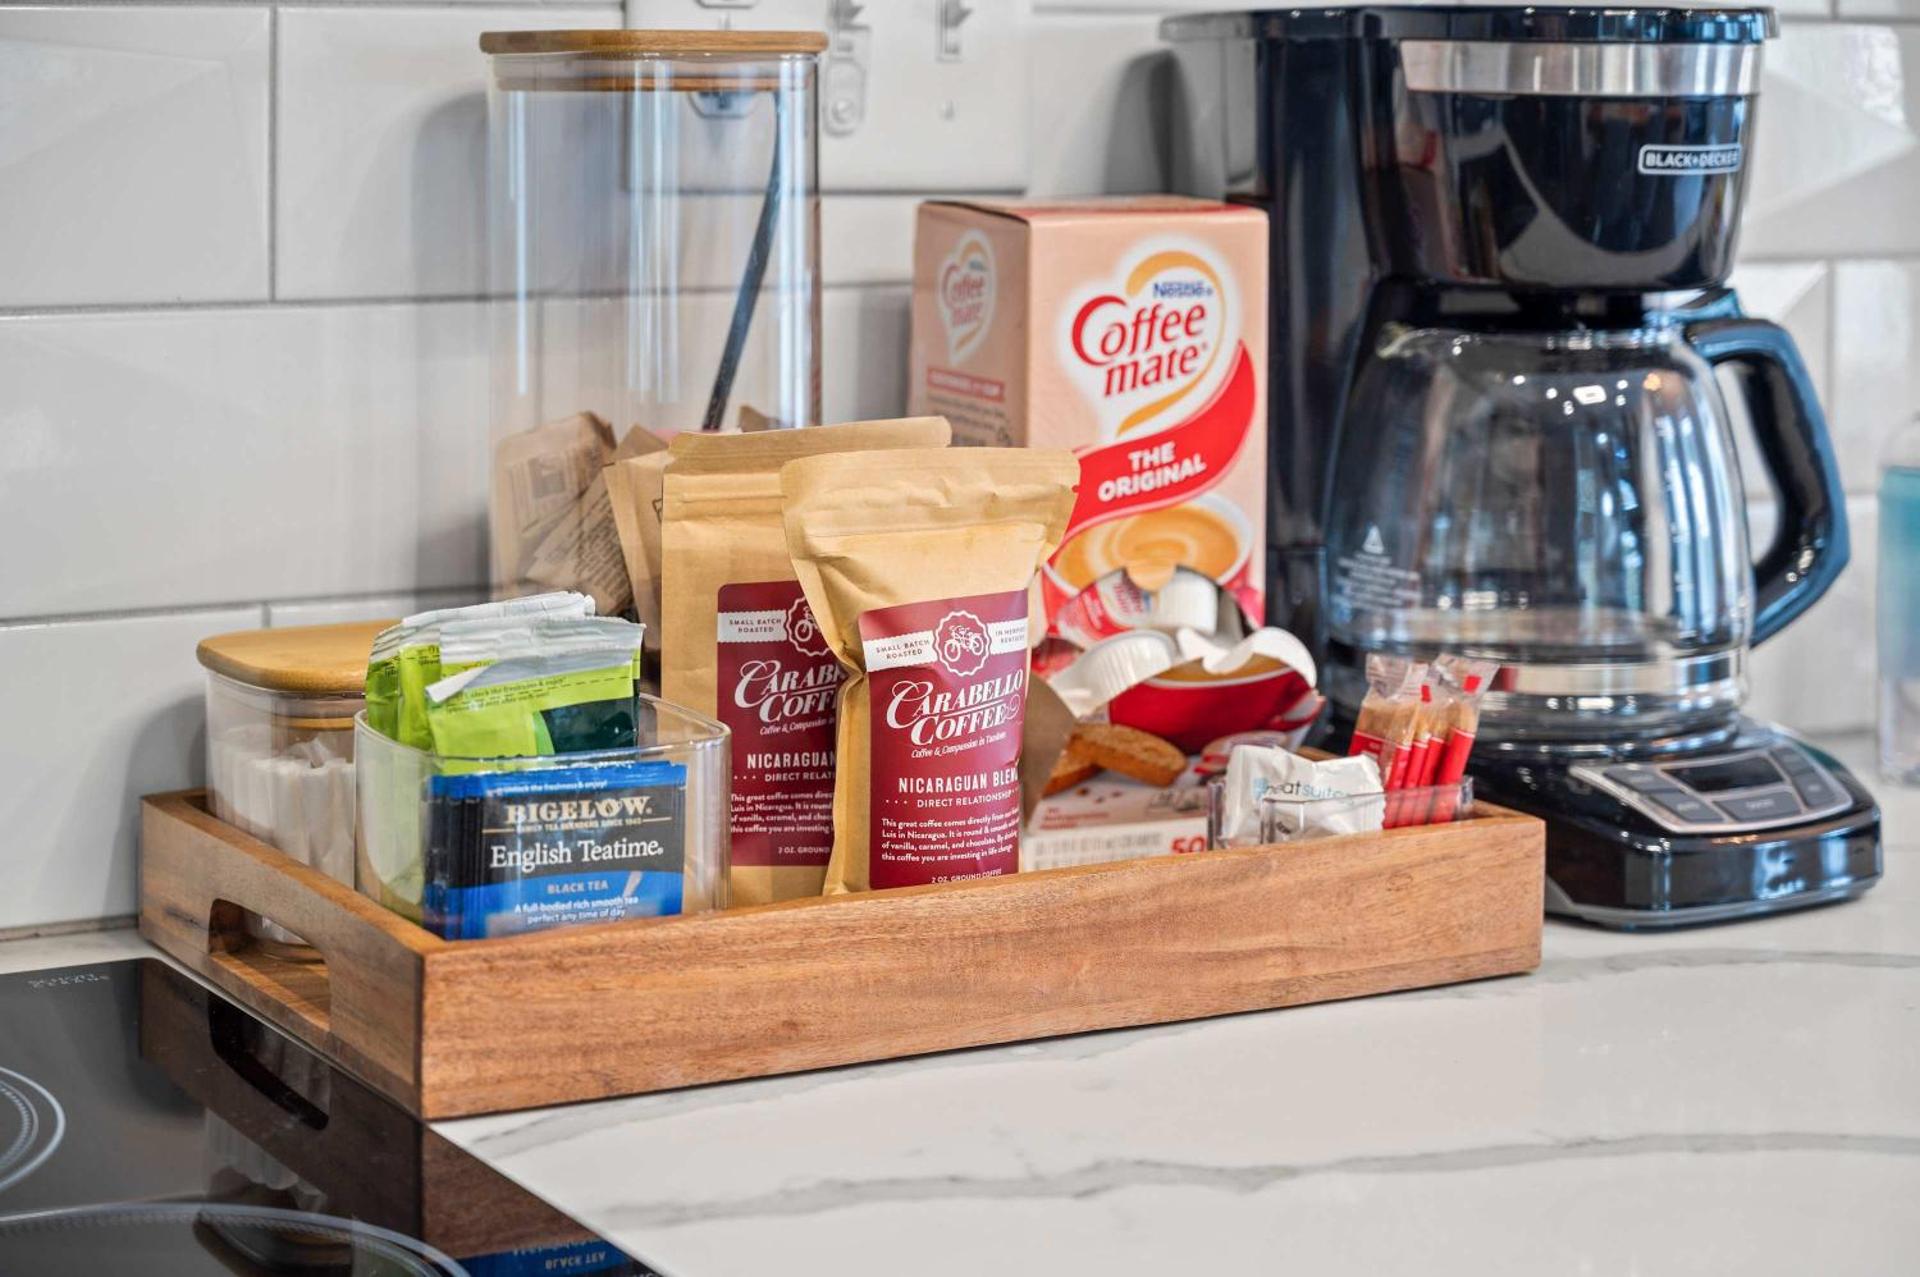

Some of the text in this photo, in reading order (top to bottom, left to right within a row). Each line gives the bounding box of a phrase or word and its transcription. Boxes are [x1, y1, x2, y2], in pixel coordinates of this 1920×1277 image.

[1071, 295, 1206, 367] Coffee
[1104, 344, 1199, 397] mate
[1128, 441, 1175, 472] THE
[1098, 454, 1207, 502] ORIGINAL
[729, 617, 782, 626] SMALL BATCH
[738, 626, 774, 634] ROASTED
[876, 638, 930, 654] SMALL BATCH
[886, 648, 923, 660] ROASTED
[759, 690, 836, 723] COFF
[886, 668, 1023, 729] CARABELLO
[911, 702, 1008, 746] COFFEE
[933, 747, 942, 757] &
[764, 772, 800, 782] DIRECT
[898, 766, 1019, 794] NICARAGUAN BLEN
[731, 793, 745, 802] This
[746, 793, 765, 804] great
[766, 791, 789, 800] coffee
[917, 790, 1011, 808] DIRECT RELATIONSHIP
[505, 796, 648, 825] BIGELOW
[744, 824, 767, 832] coffee
[768, 825, 782, 835] you
[881, 818, 897, 827] This
[898, 820, 918, 830] great
[919, 819, 942, 828] coffee
[943, 818, 967, 827] comes
[882, 829, 897, 838] Luis
[898, 830, 906, 838] in
[907, 831, 947, 841] Nicaragua.
[949, 830, 956, 838] It
[963, 826, 983, 837] round
[882, 840, 890, 849] of
[891, 842, 918, 851] vanilla,
[919, 842, 950, 851] caramel,
[951, 840, 965, 848] and
[490, 838, 659, 873] English Teatime
[882, 852, 896, 861] this
[897, 852, 920, 861] coffee
[921, 855, 935, 864] you
[949, 851, 981, 860] investing
[931, 876, 937, 884] 2
[950, 872, 980, 882] GROUND
[547, 879, 609, 895] BLACK TEA
[514, 903, 521, 913] A
[573, 899, 590, 909] rich
[591, 896, 623, 908] smooth
[624, 896, 639, 905] tea
[527, 906, 626, 924] perfect any time of day
